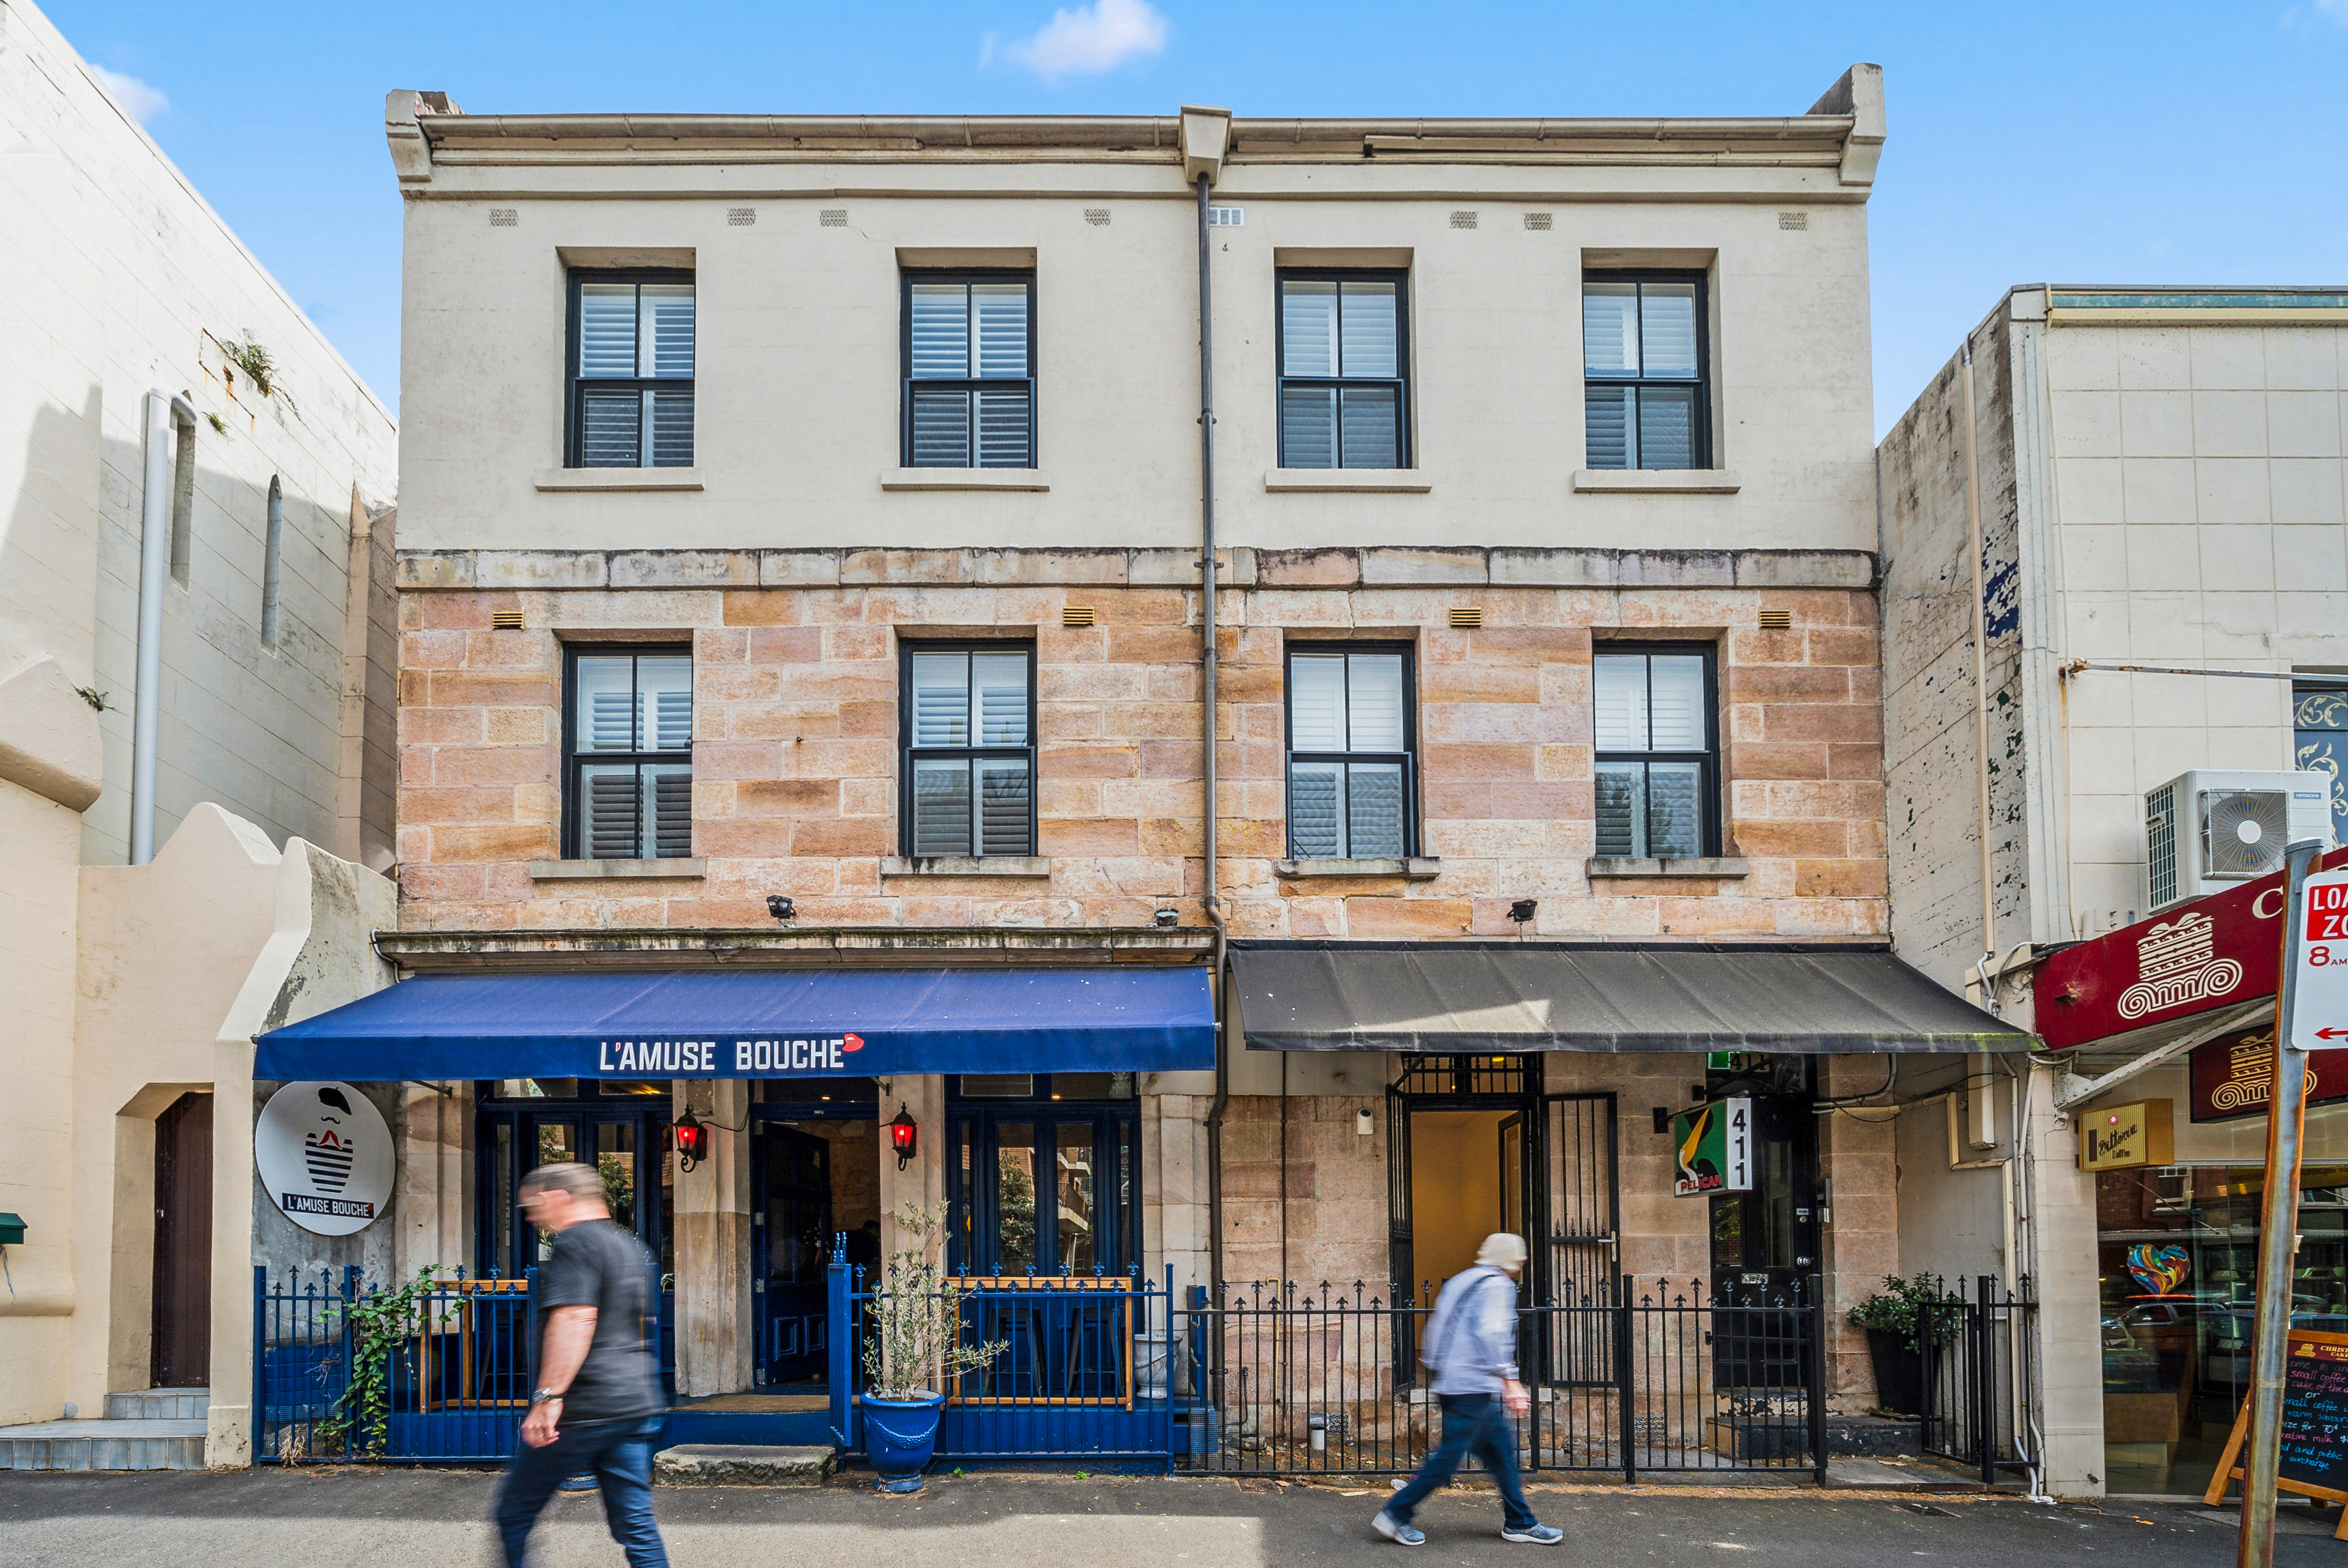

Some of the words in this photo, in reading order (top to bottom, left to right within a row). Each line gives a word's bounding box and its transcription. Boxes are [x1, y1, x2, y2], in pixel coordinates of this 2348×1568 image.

[600, 1041, 716, 1070] L'AMUSE
[736, 1039, 844, 1070] BOUCHE
[1681, 1175, 1721, 1191] PELICAN
[287, 1195, 330, 1213] L'AMUSE
[332, 1201, 369, 1217] BOUCHE
[2290, 1370, 2317, 1380] small
[2320, 1372, 2345, 1383] coffee
[2292, 1380, 2313, 1390] cake
[2315, 1381, 2326, 1393] of
[2328, 1383, 2342, 1392] the
[2313, 1400, 2338, 1412] coffee
[2301, 1421, 2316, 1432] for
[2313, 1434, 2332, 1443] milk
[2295, 1447, 2314, 1455] and
[2316, 1450, 2343, 1460] public
[2289, 1456, 2329, 1472] surcharge
